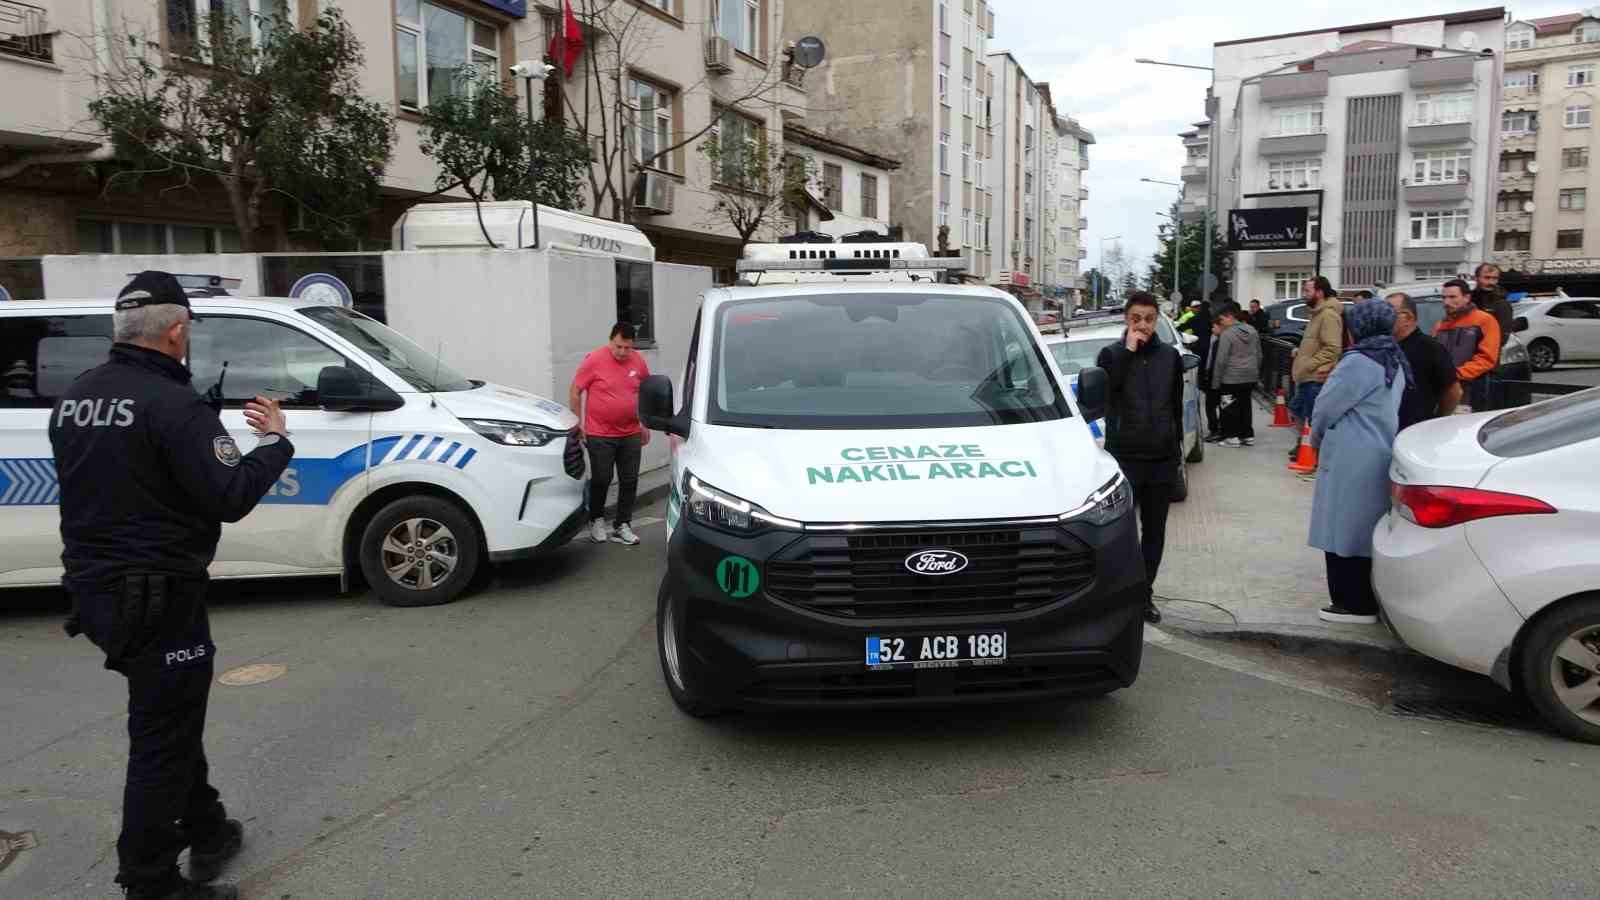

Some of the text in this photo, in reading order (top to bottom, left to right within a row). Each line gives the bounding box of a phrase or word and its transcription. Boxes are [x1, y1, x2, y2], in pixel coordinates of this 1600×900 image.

[840, 444, 985, 461] CENAZE
[928, 460, 1037, 480] ARACI
[914, 552, 957, 572] Ford
[879, 638, 905, 662] 52
[919, 635, 959, 660] ACB
[967, 633, 1003, 658] 188
